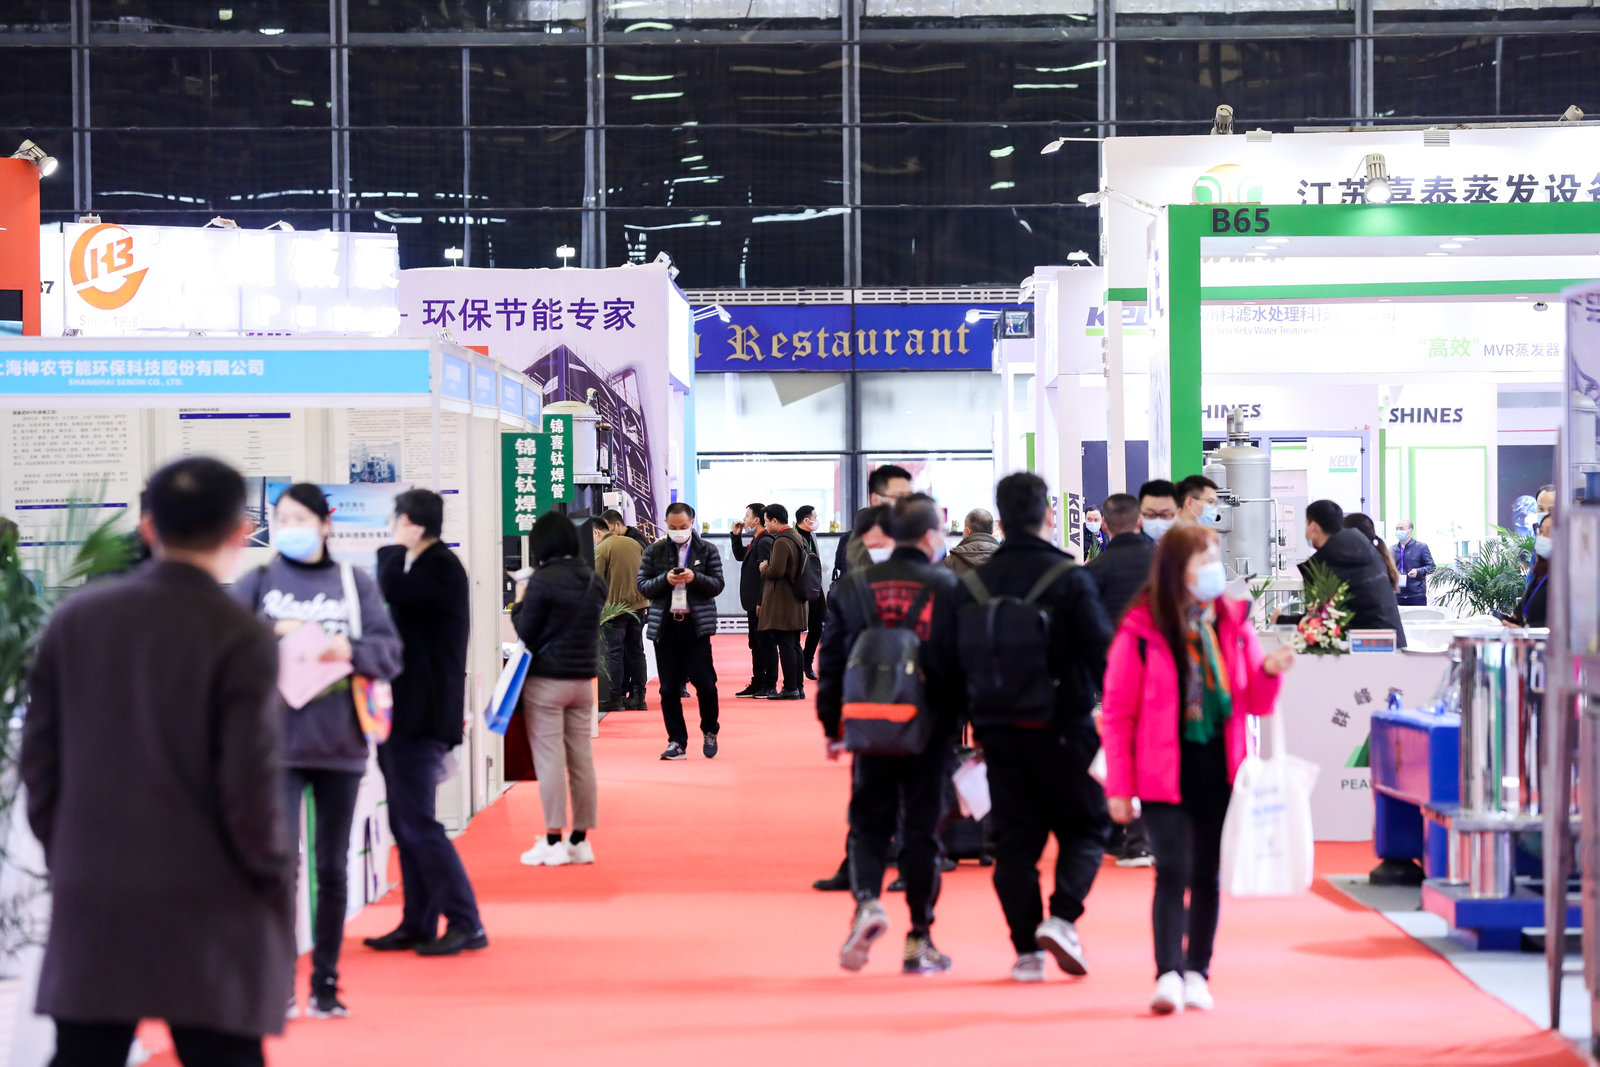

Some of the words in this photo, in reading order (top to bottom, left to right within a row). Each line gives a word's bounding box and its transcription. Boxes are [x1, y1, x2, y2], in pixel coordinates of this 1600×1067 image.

[1212, 208, 1270, 233] B65
[422, 297, 636, 332] 环保节能专家
[725, 323, 971, 362] Restaurant
[1484, 342, 1560, 357] MVR蒸发器
[1388, 407, 1463, 423] SHINES
[550, 418, 565, 499] 锦喜钛焊管
[514, 438, 537, 532] 锦喜钛焊管
[1341, 779, 1373, 790] PEA
